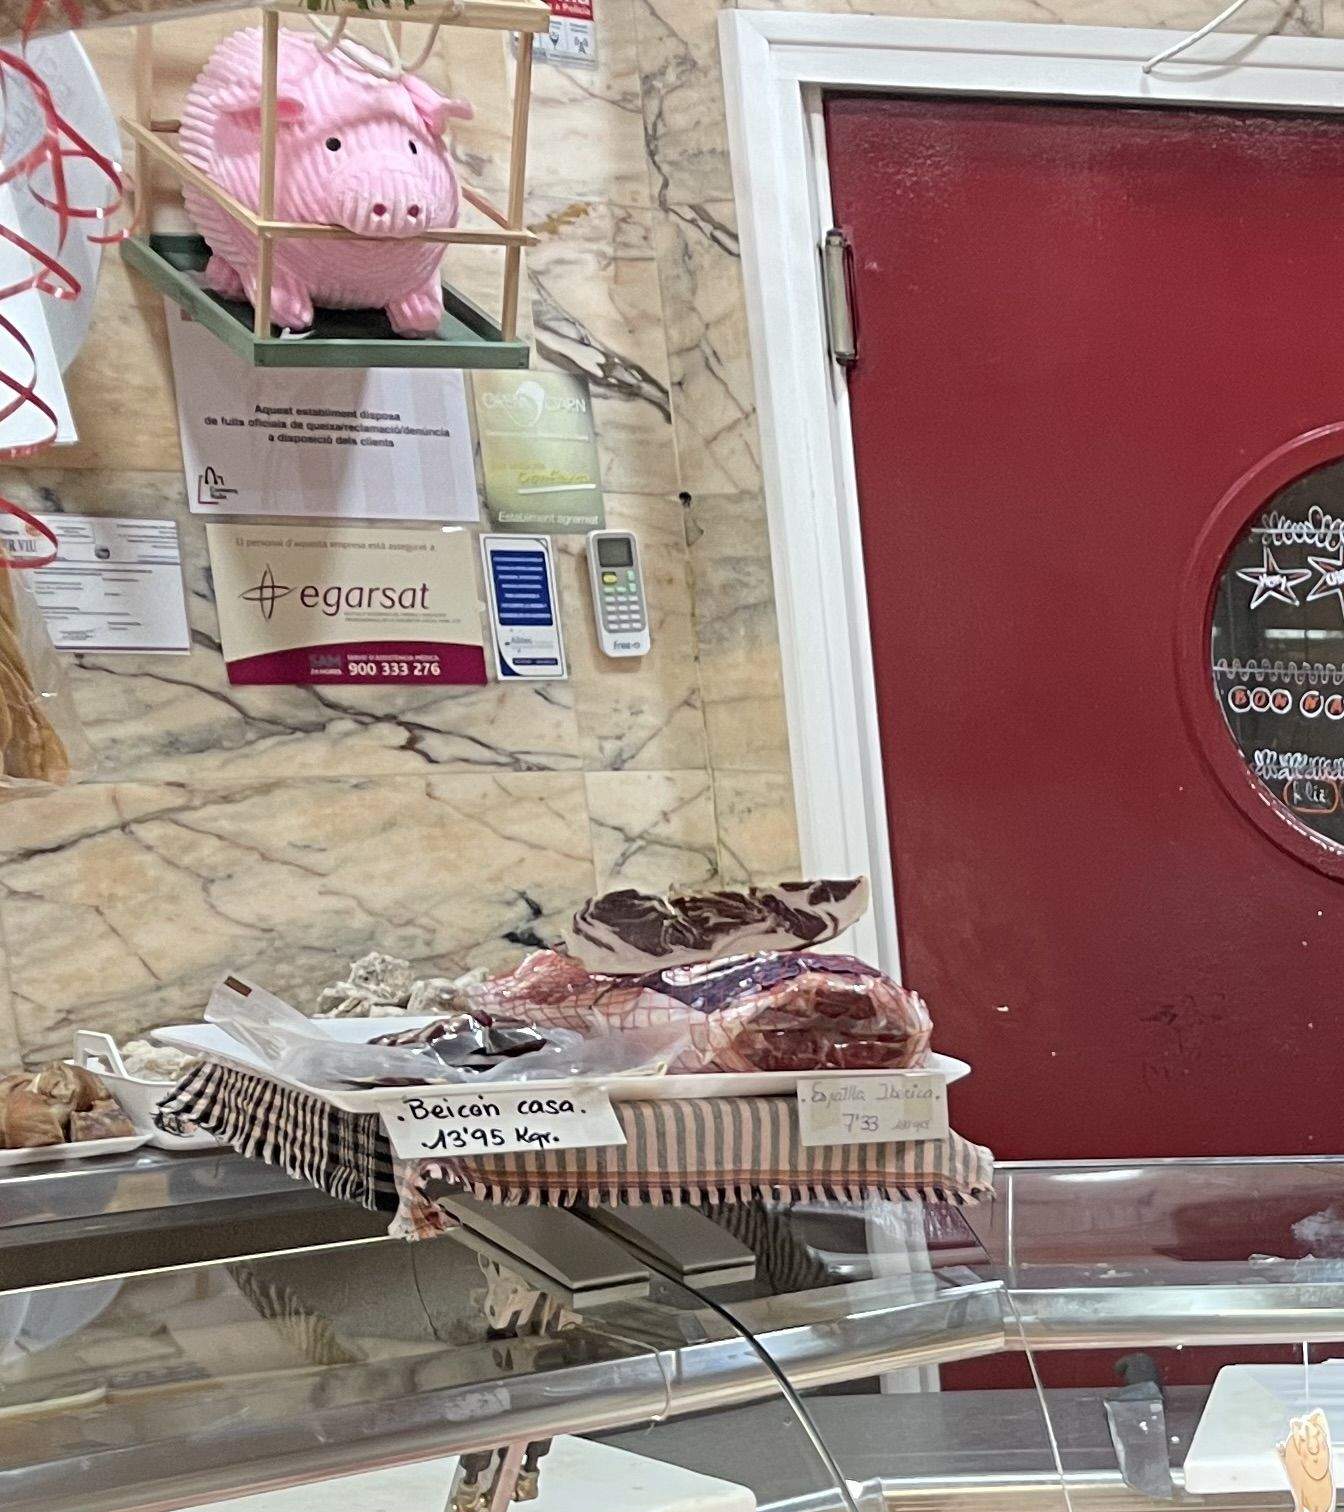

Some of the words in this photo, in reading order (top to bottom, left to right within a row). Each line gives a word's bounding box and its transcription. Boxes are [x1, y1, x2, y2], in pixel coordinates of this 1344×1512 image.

[300, 582, 430, 617] egarsat
[349, 662, 376, 676] 900
[382, 662, 409, 676] 333
[413, 662, 441, 676] 276
